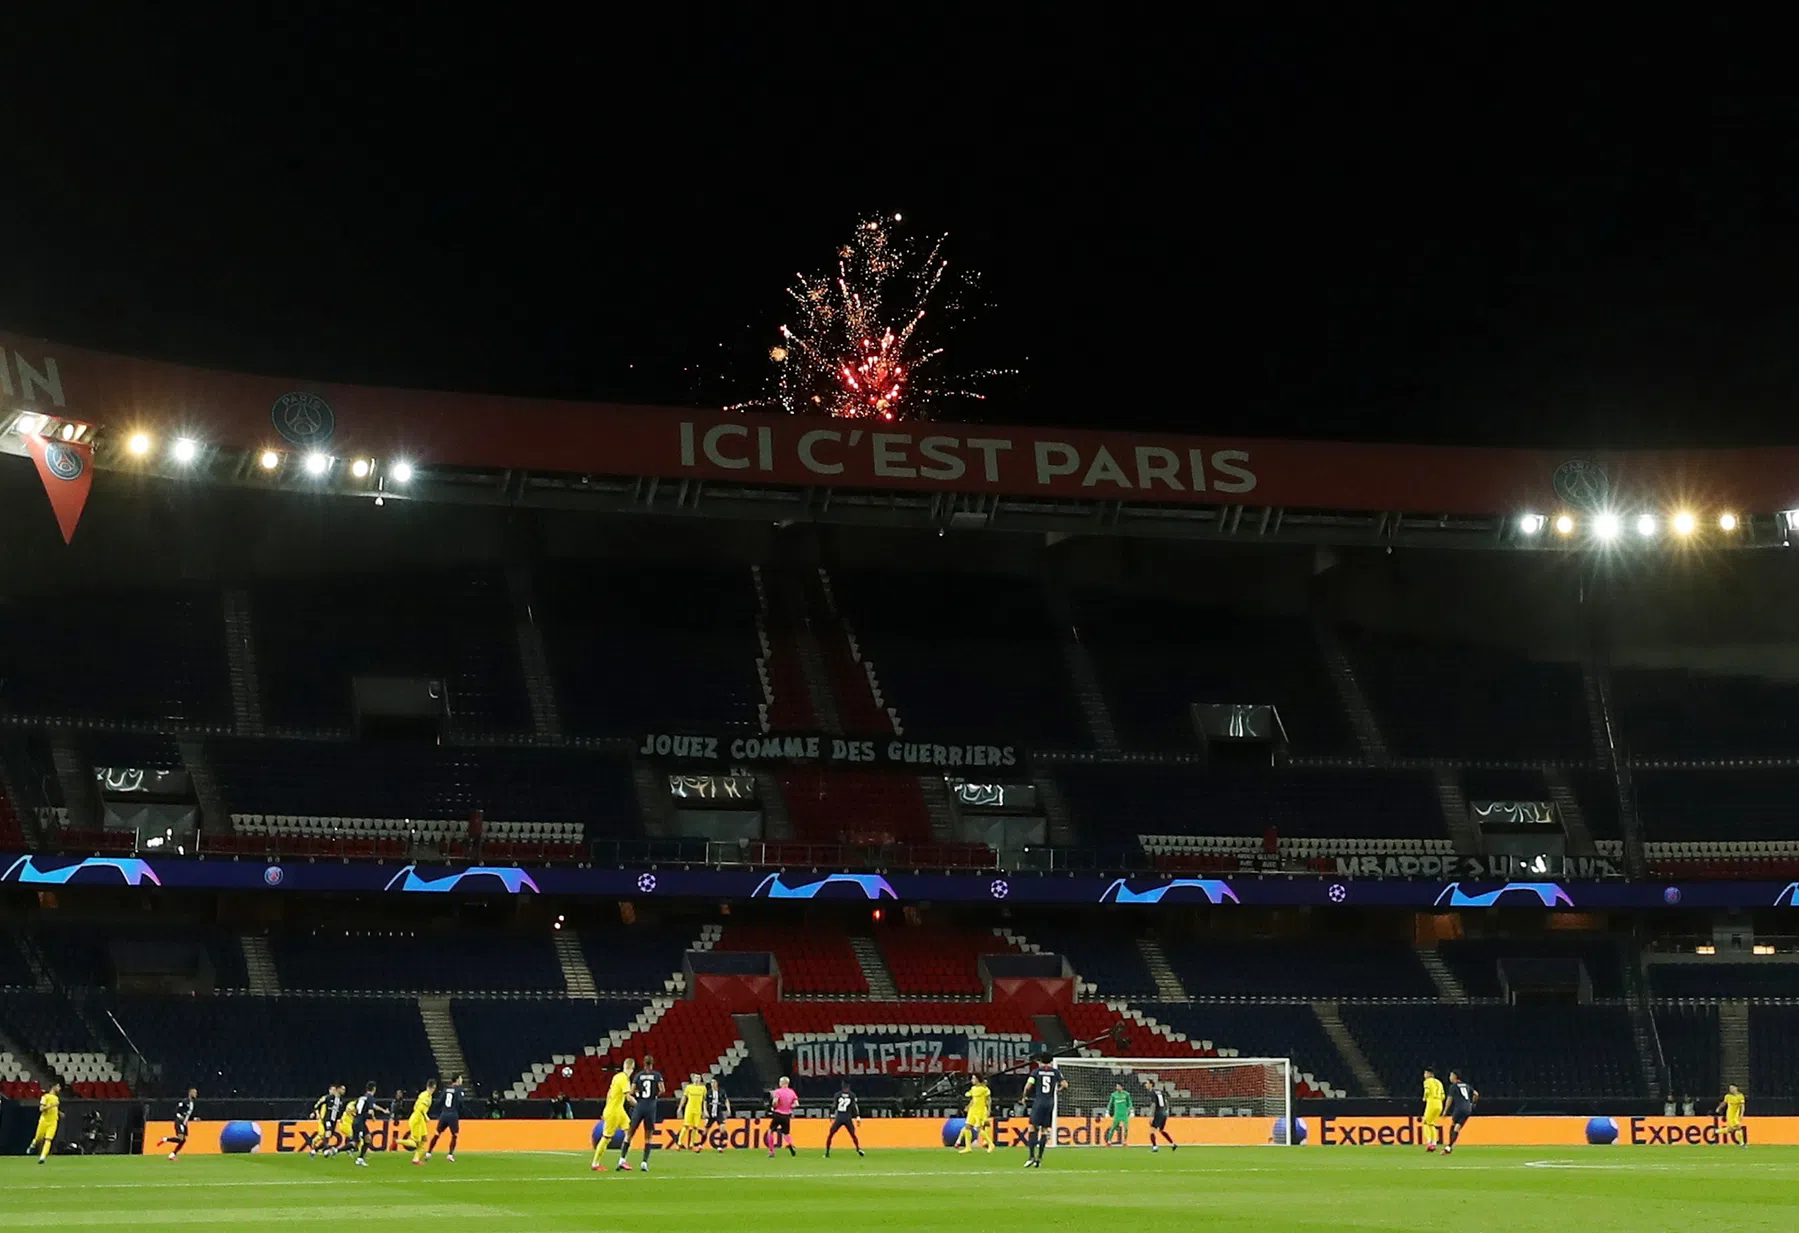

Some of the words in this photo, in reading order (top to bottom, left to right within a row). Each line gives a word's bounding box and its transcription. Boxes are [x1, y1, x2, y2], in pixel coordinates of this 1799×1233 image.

[679, 421, 774, 471] ICI
[797, 429, 1014, 483] C'EST
[1034, 440, 1258, 494] PARIS
[640, 734, 718, 759] JOUEZ
[730, 737, 820, 760] COMME
[831, 739, 876, 762] DES
[888, 741, 1016, 766] GUERRIERS
[641, 1080, 653, 1099] 3
[1041, 1076, 1051, 1094] 5
[444, 1093, 455, 1108] 8
